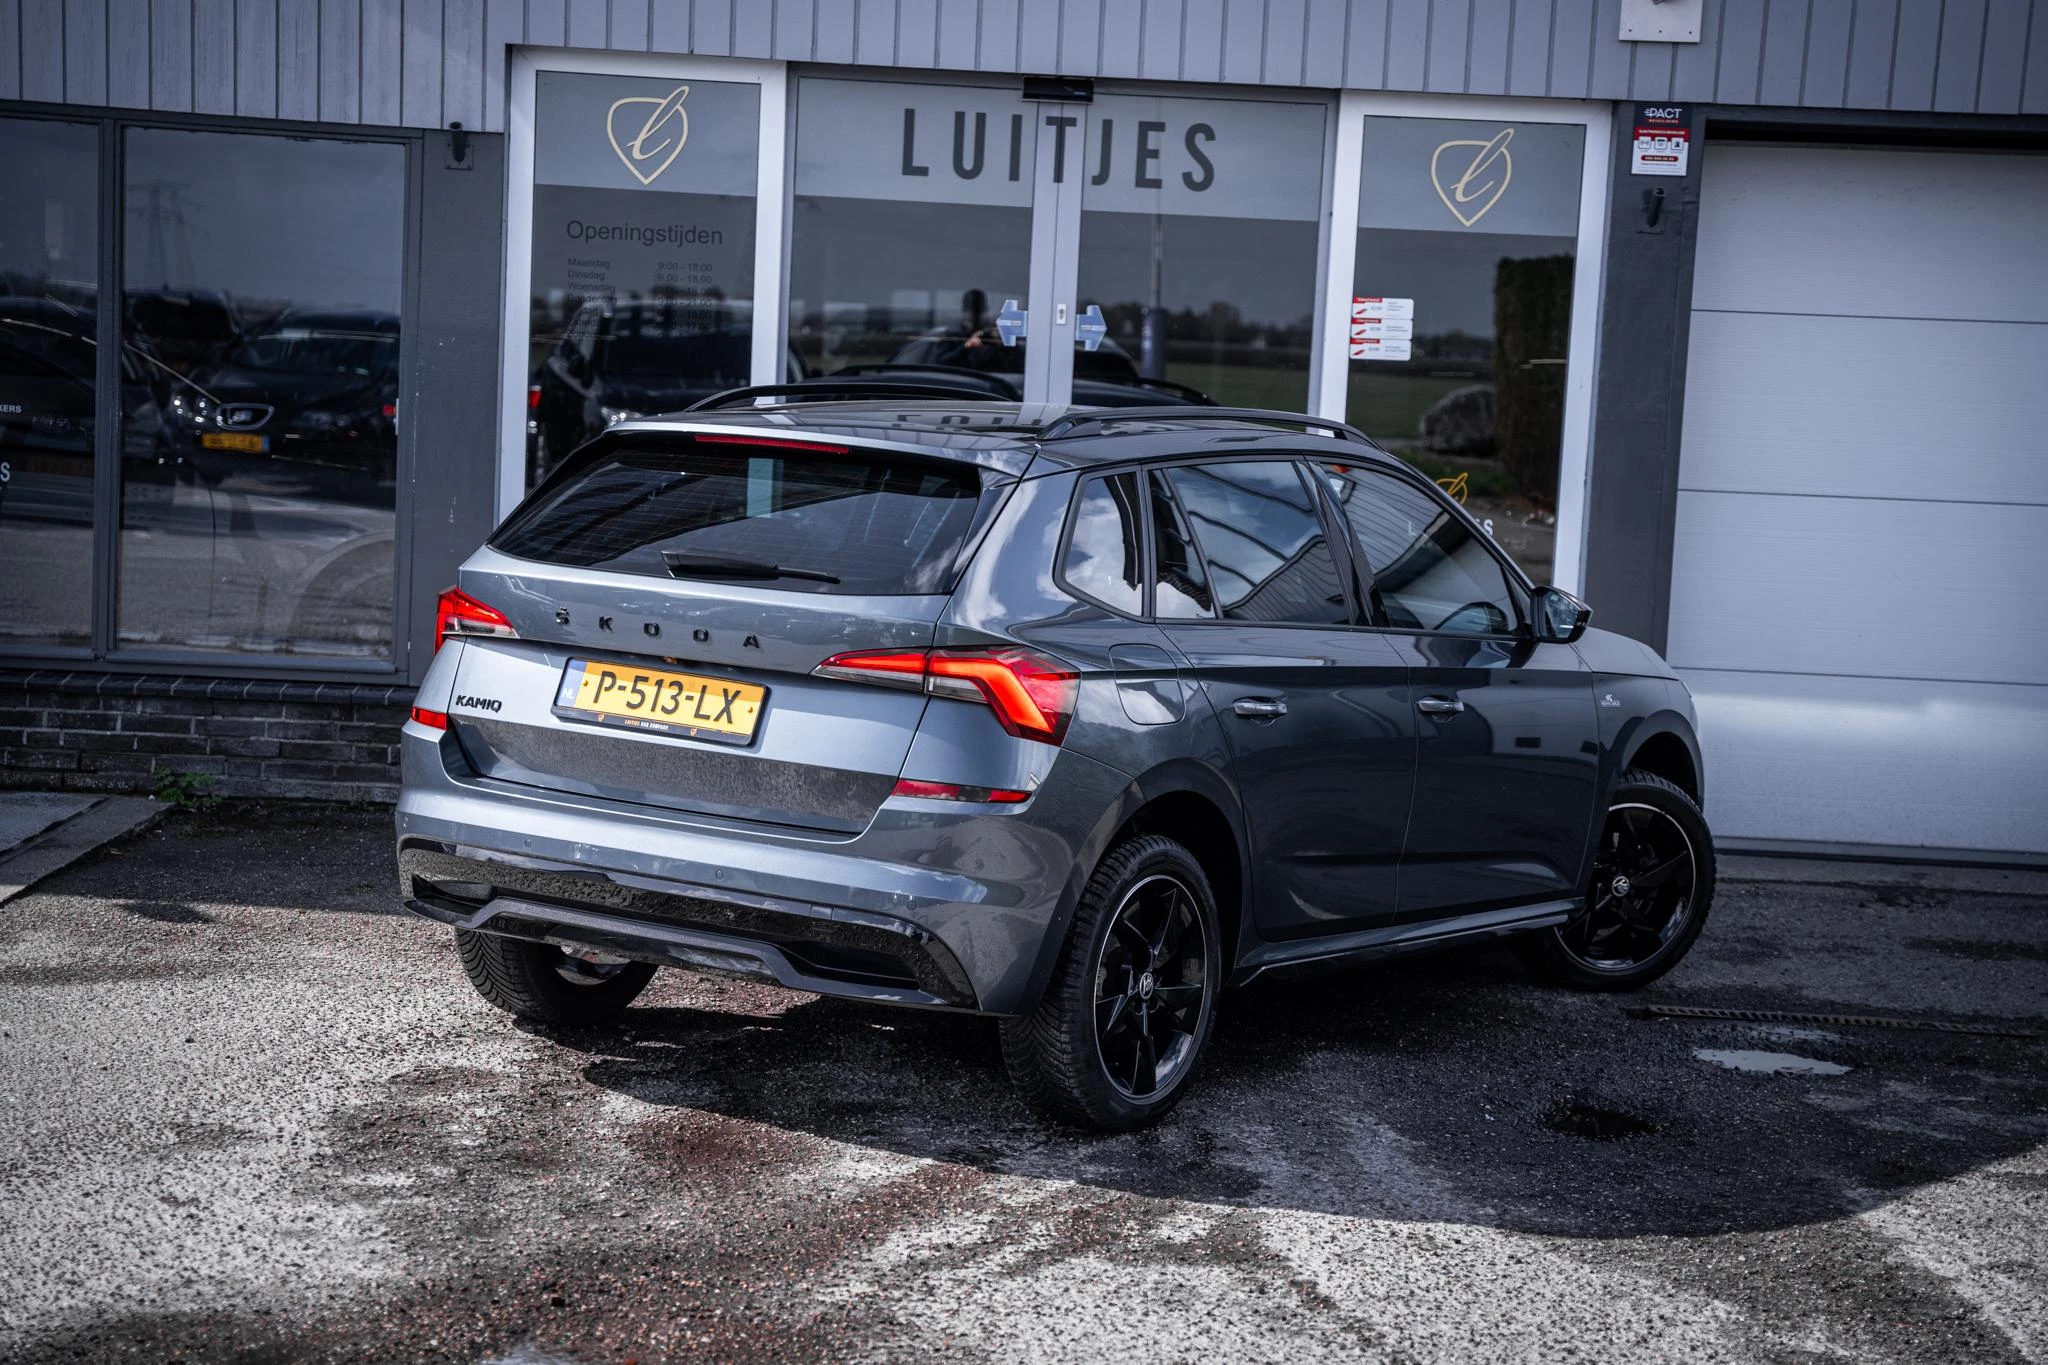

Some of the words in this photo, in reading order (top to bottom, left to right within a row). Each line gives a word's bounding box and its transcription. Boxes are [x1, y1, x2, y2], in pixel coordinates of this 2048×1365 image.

[1646, 107, 1682, 118] PACT
[902, 108, 1217, 192] LUITJES
[567, 220, 723, 248] Openingstijden
[456, 695, 502, 713] KAMIQ
[562, 687, 575, 700] NL
[593, 670, 742, 724] P-513-LX
